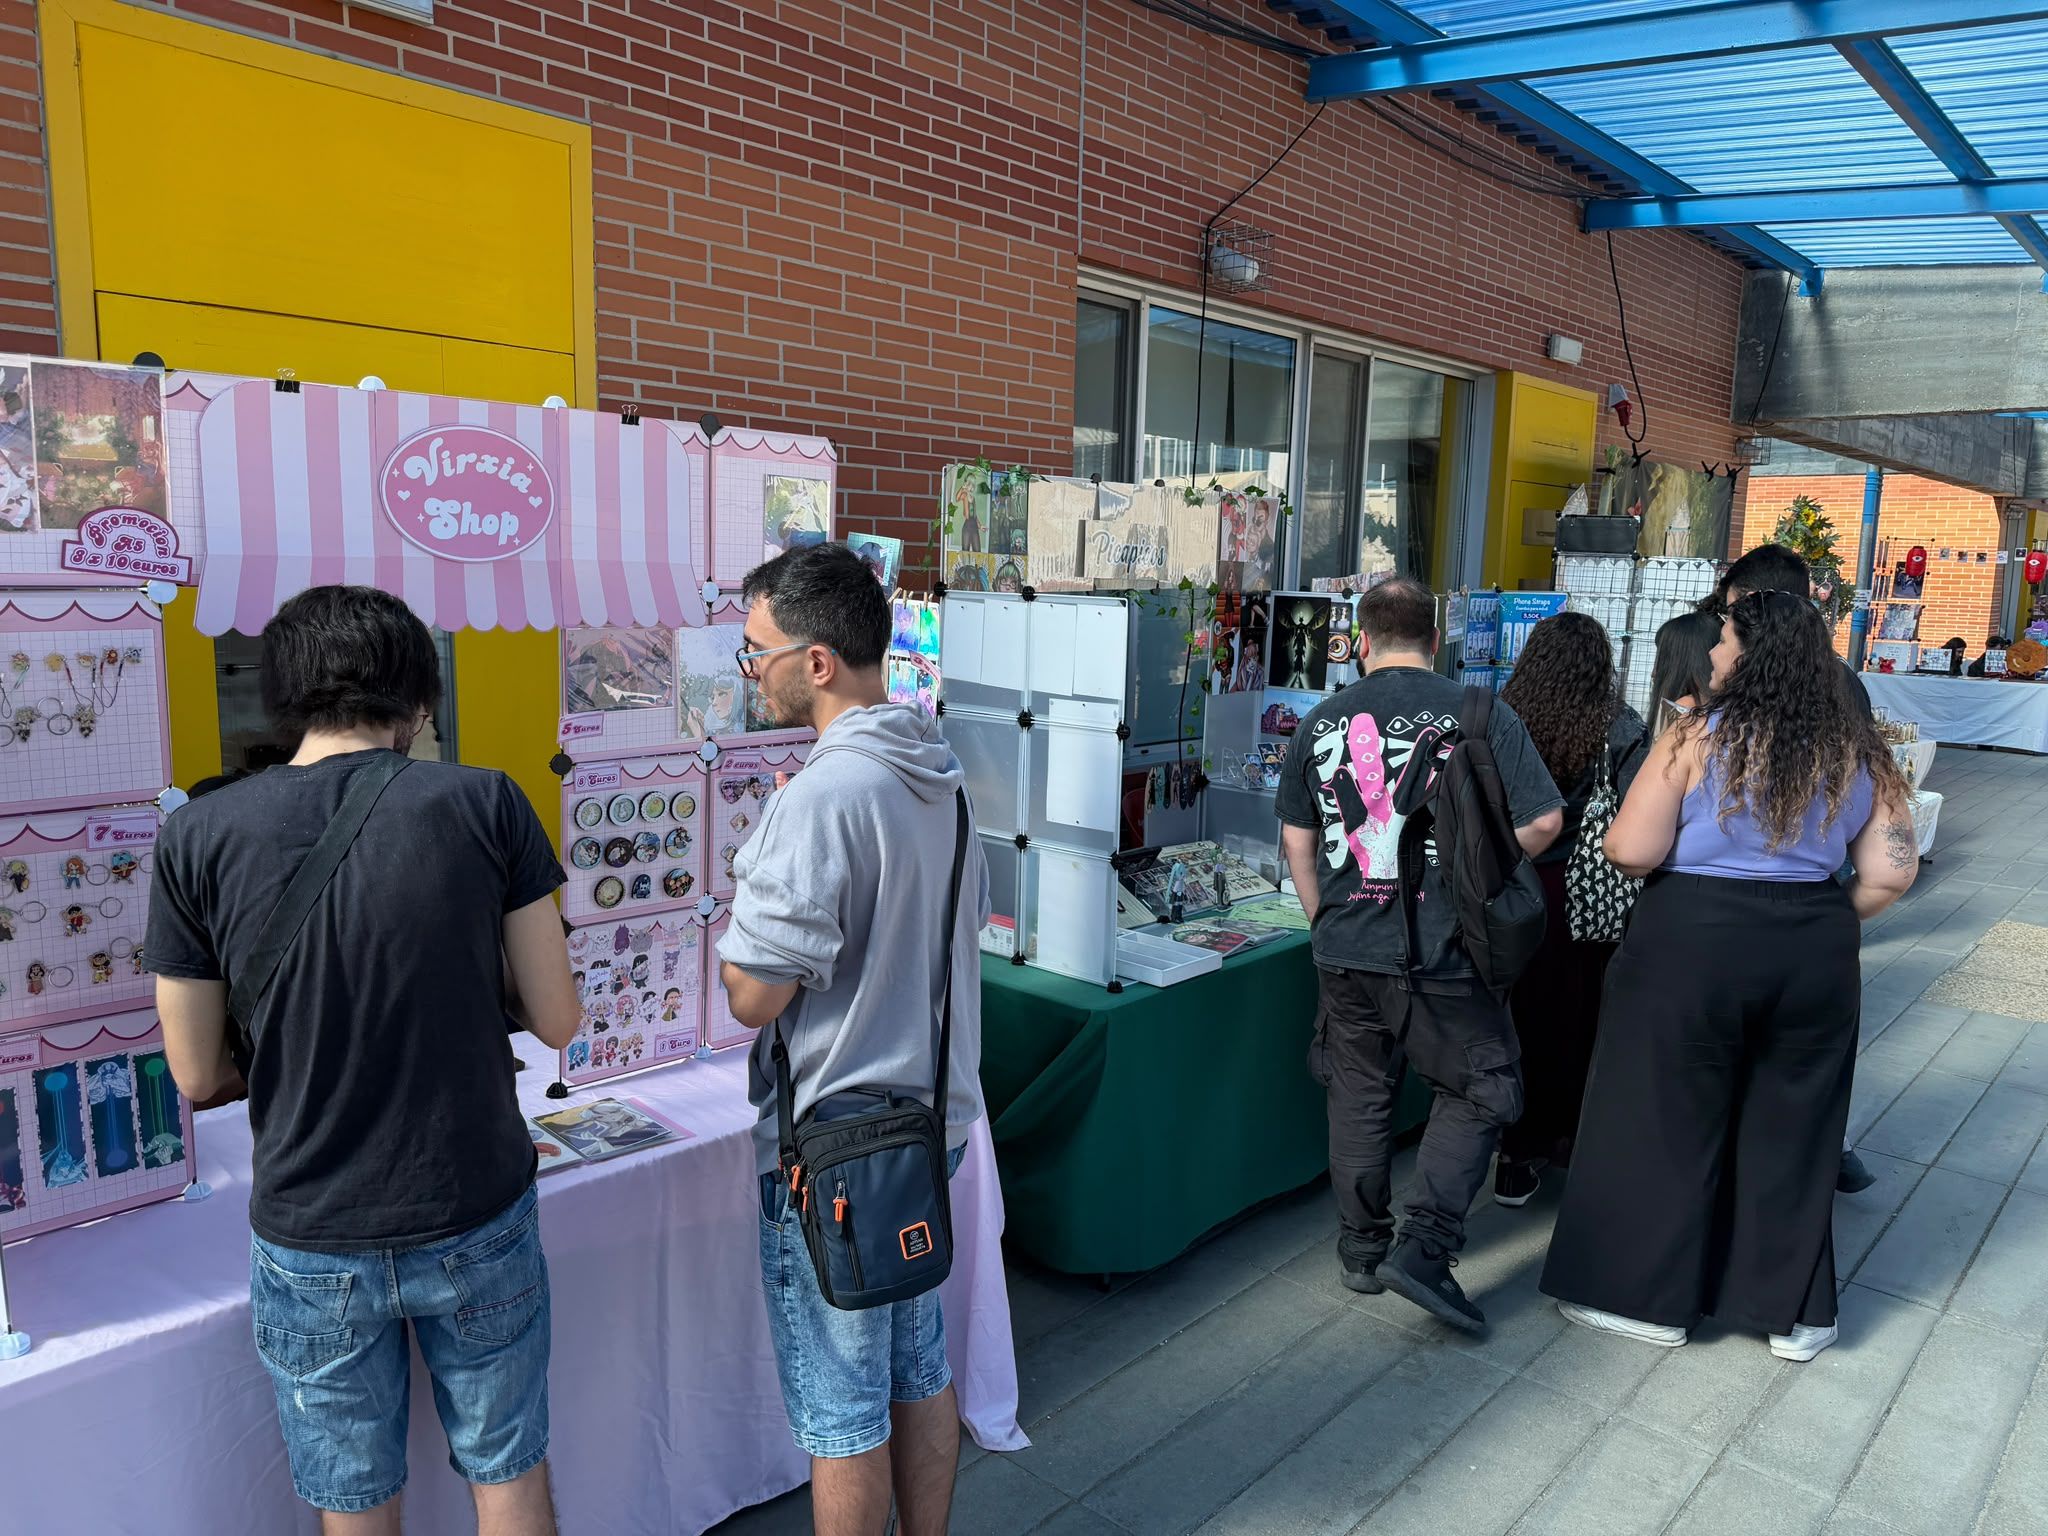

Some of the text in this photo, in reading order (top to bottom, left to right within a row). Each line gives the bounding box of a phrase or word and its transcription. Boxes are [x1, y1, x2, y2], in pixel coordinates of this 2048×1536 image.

[403, 437, 532, 493] Virxia
[424, 497, 519, 546] Shop
[113, 534, 145, 553] A5
[1091, 530, 1166, 574] Picapicos
[106, 553, 130, 570] 10
[131, 559, 179, 575] euros
[562, 723, 572, 735] 5
[587, 773, 617, 786] Euros
[95, 825, 154, 841] 7 Euros
[669, 1038, 691, 1050] Euro
[0, 1054, 33, 1064] uros
